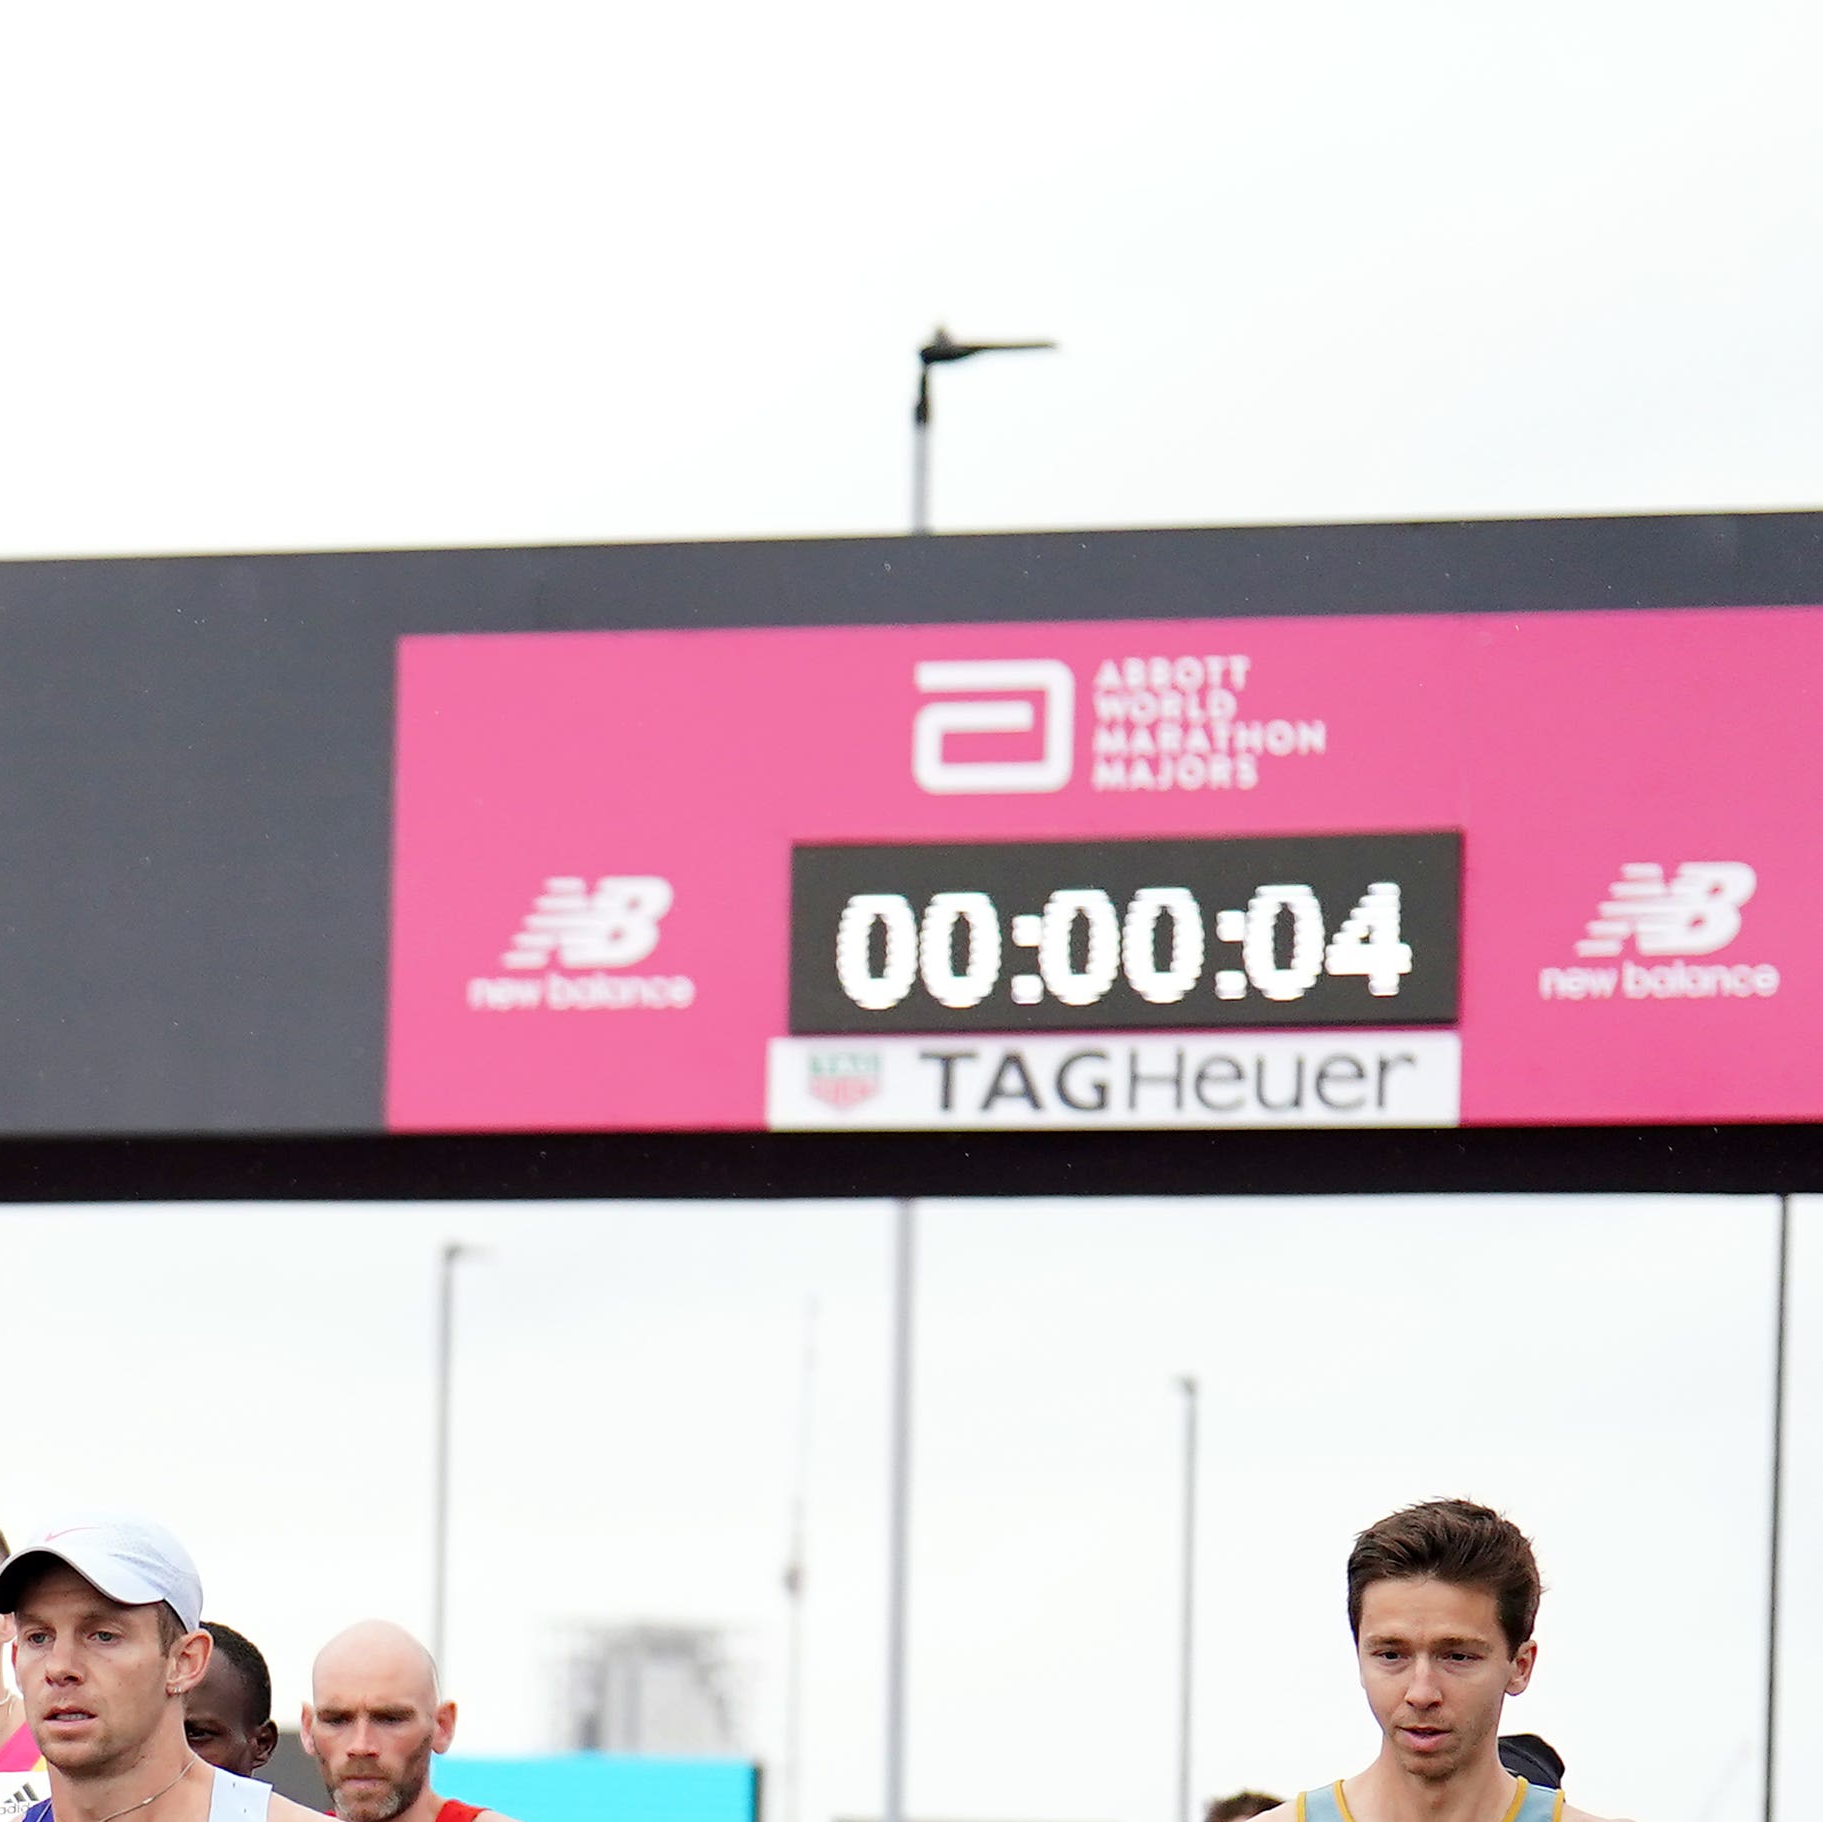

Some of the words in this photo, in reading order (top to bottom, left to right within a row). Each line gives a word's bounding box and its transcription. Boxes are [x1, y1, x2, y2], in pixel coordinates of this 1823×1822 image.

[1093, 655, 1252, 692] ABBOTT
[1092, 688, 1237, 728] WORLD
[1092, 718, 1328, 757] MARATHON
[1091, 752, 1260, 793] MAJORS
[836, 883, 1412, 1010] 00:00:04
[467, 978, 541, 1011] new
[546, 971, 697, 1012] balance
[1539, 967, 1614, 1000] new
[1622, 960, 1779, 999] balance
